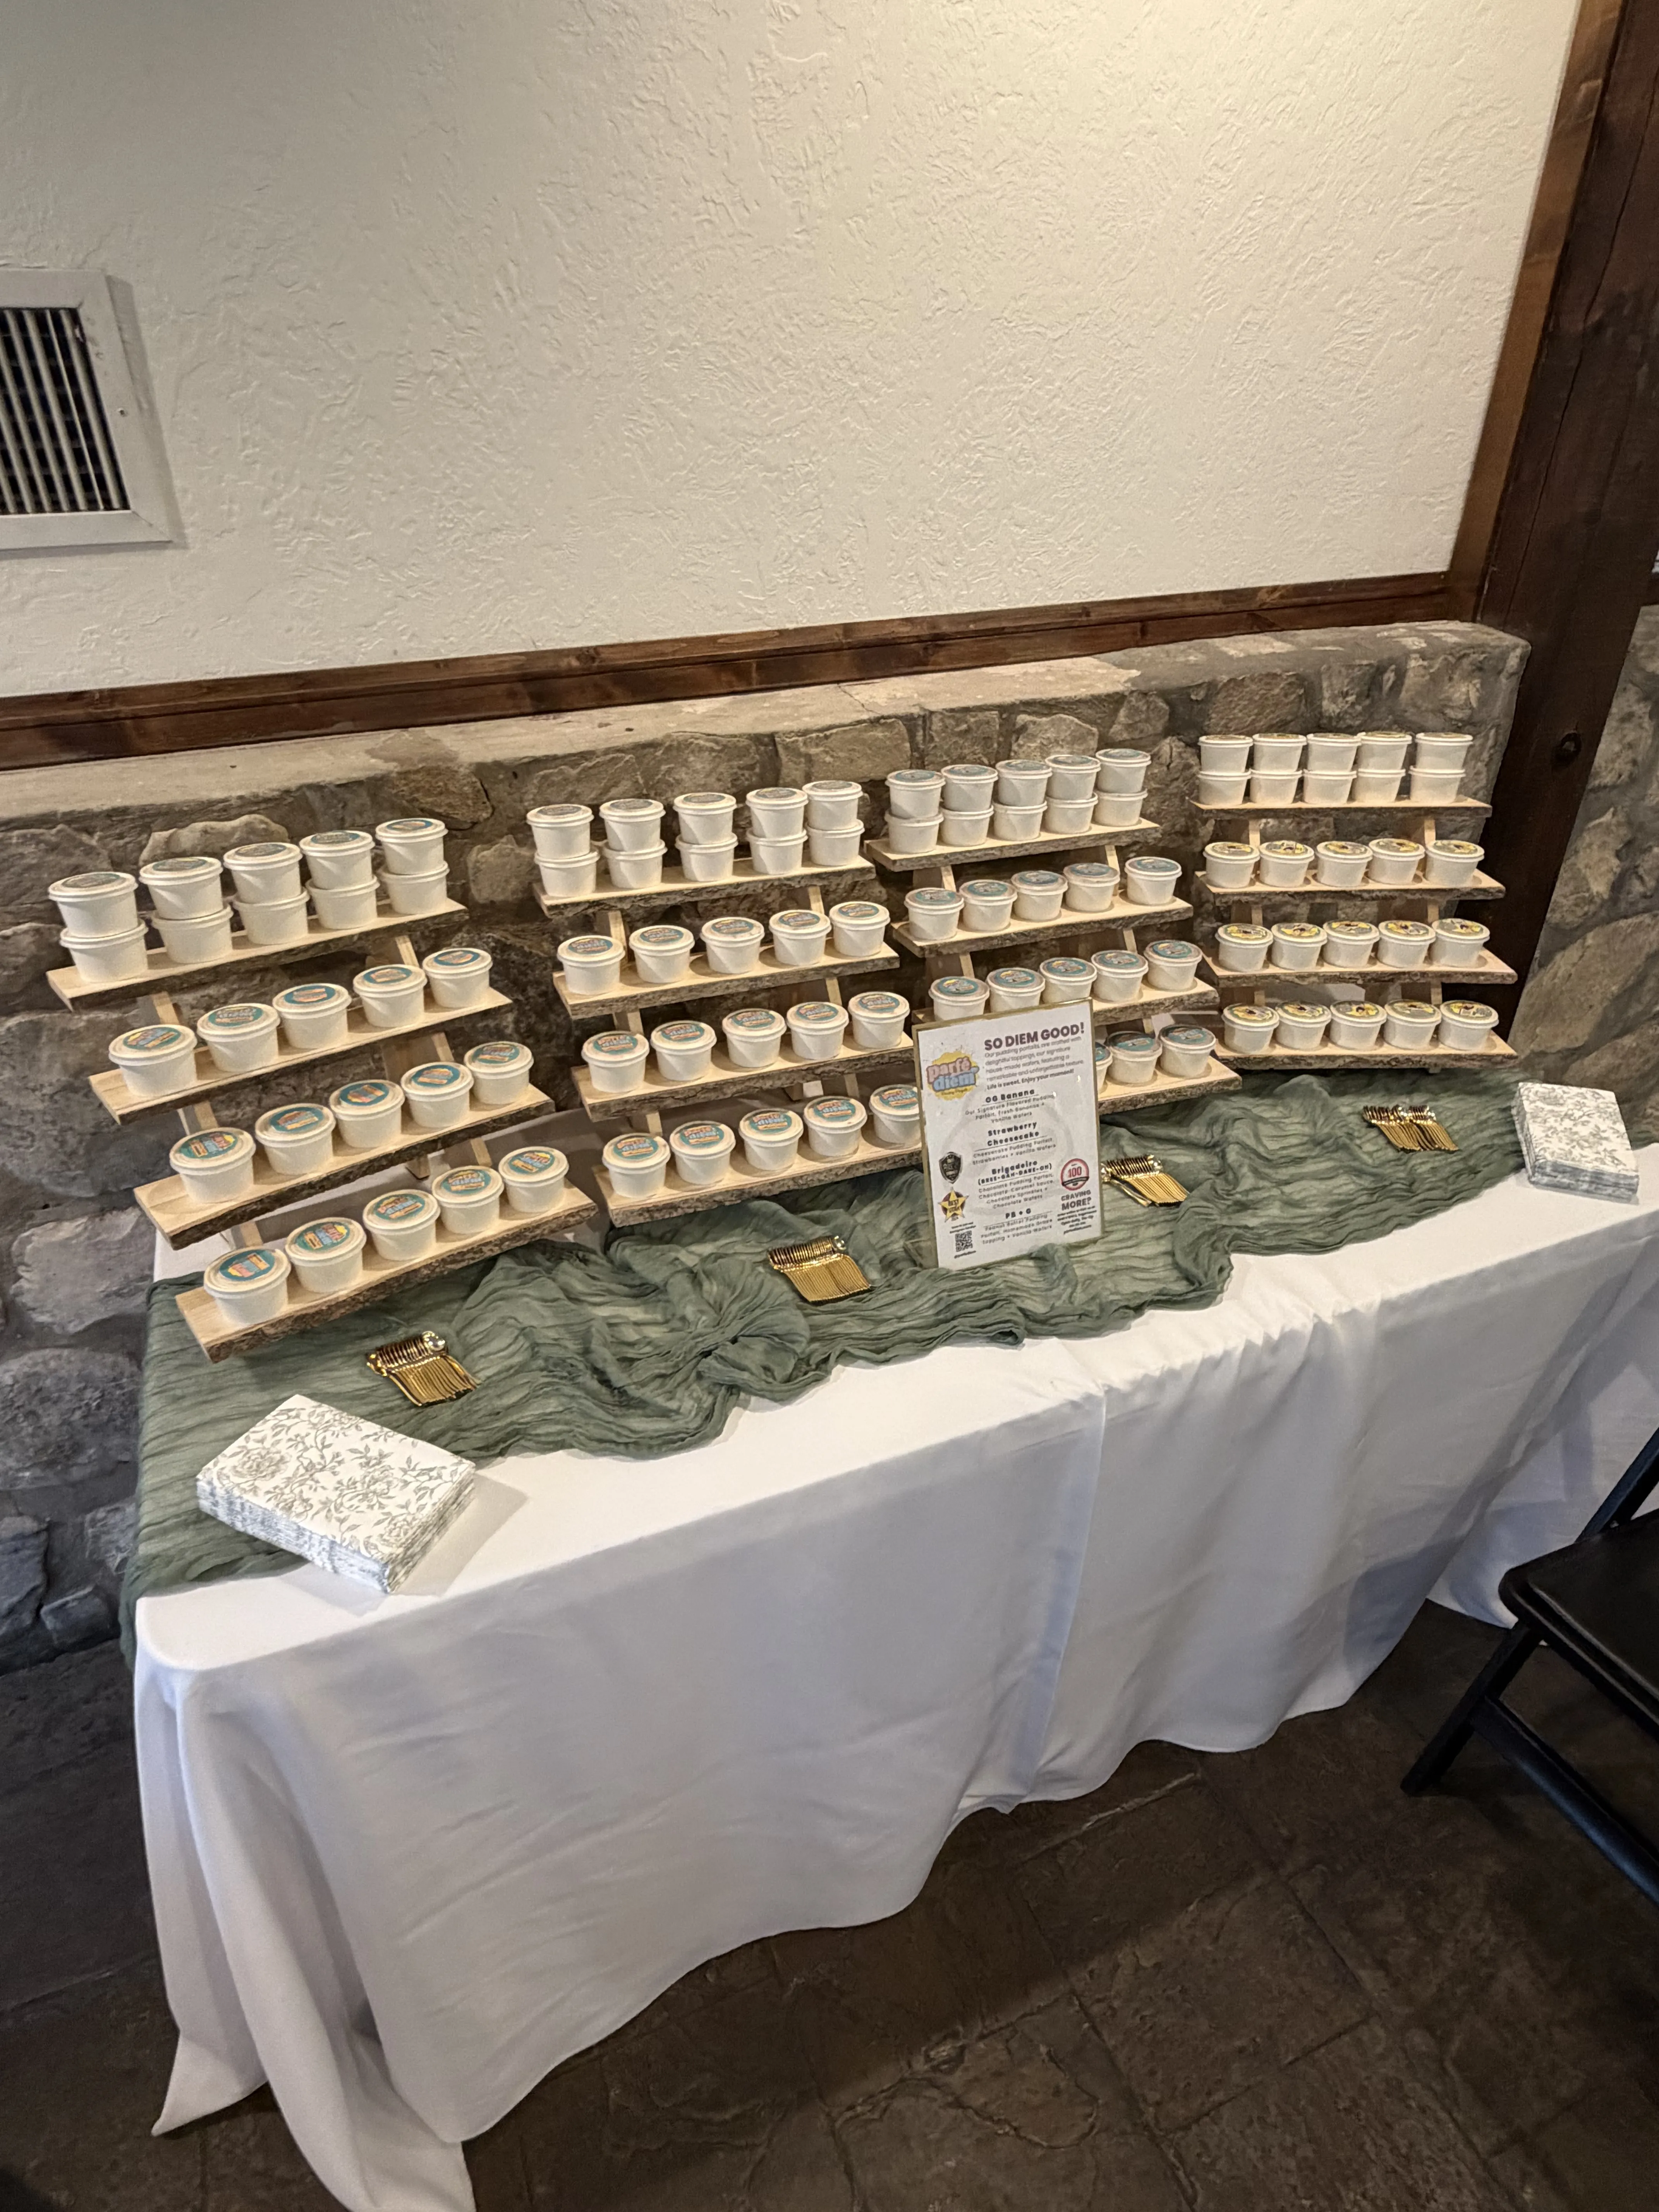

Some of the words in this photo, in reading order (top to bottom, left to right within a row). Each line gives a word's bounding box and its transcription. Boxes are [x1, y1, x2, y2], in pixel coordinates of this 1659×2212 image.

[984, 1038, 1002, 1050] SO
[1005, 1031, 1038, 1047] DIEM
[1041, 1022, 1084, 1040] GOOD!
[932, 1071, 976, 1092] diem
[1001, 1089, 1034, 1100] Banana
[977, 1104, 1005, 1113] Signature
[988, 1122, 1037, 1136] Strawberry
[987, 1132, 1039, 1146] Cheesecake
[991, 1160, 1037, 1175] Brigadeiro
[1068, 1166, 1082, 1178] 100
[1061, 1190, 1091, 1201] CRAVING
[1061, 1197, 1091, 1211] MORE?
